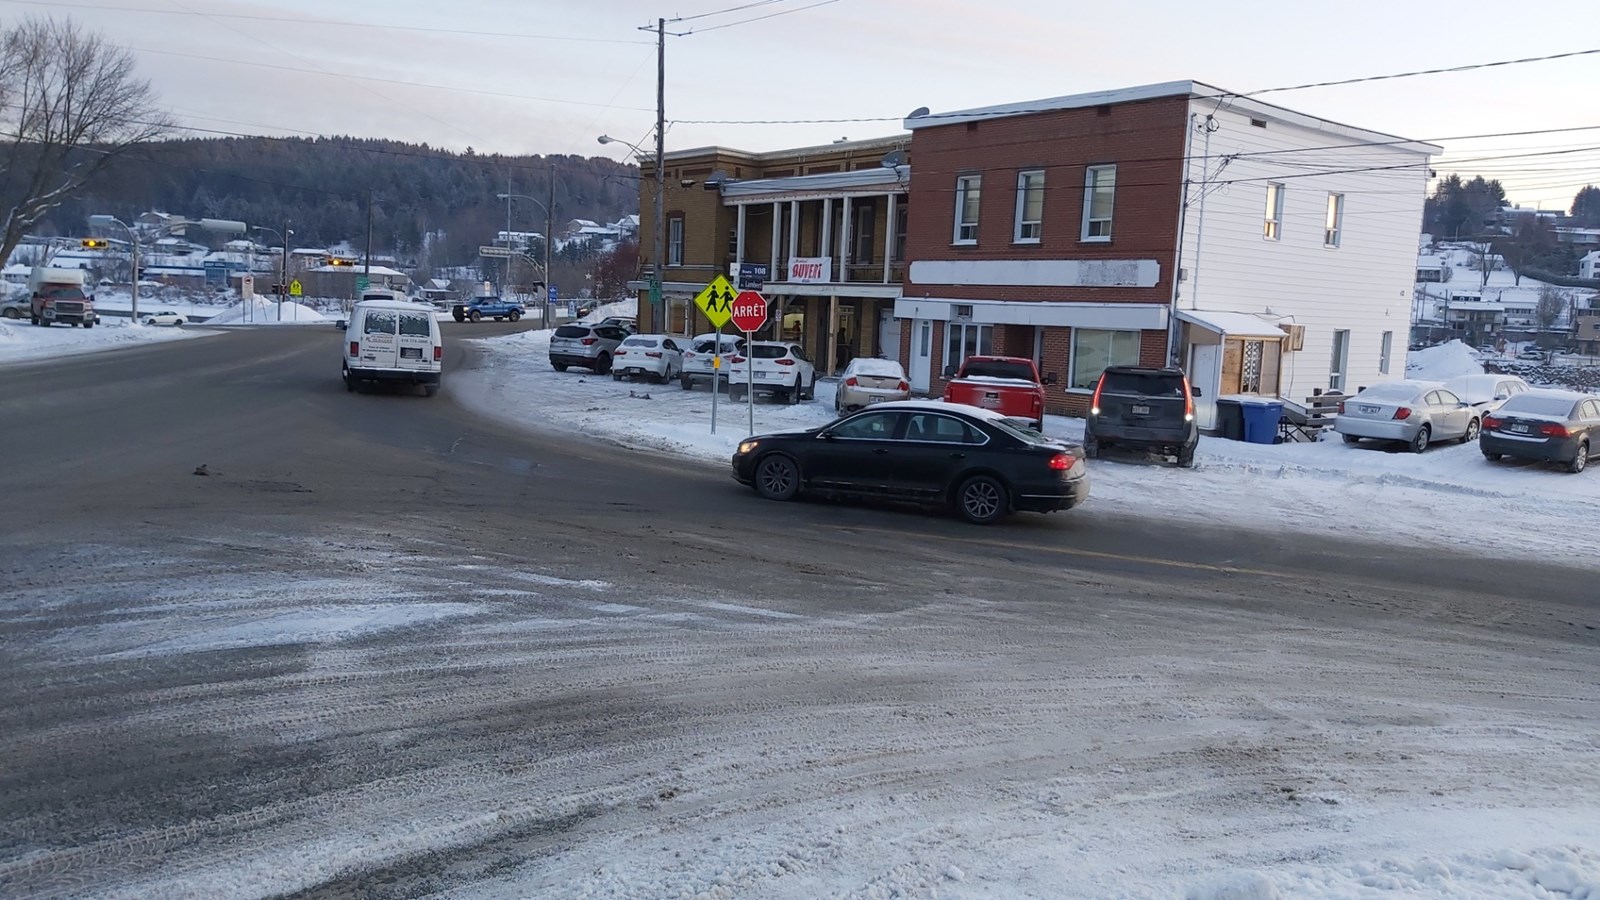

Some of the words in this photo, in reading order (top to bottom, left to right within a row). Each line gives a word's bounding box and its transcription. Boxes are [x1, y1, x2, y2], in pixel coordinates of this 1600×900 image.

[754, 267, 766, 275] 108
[792, 263, 822, 278] OUVERT
[733, 303, 765, 317] ARRÊT
